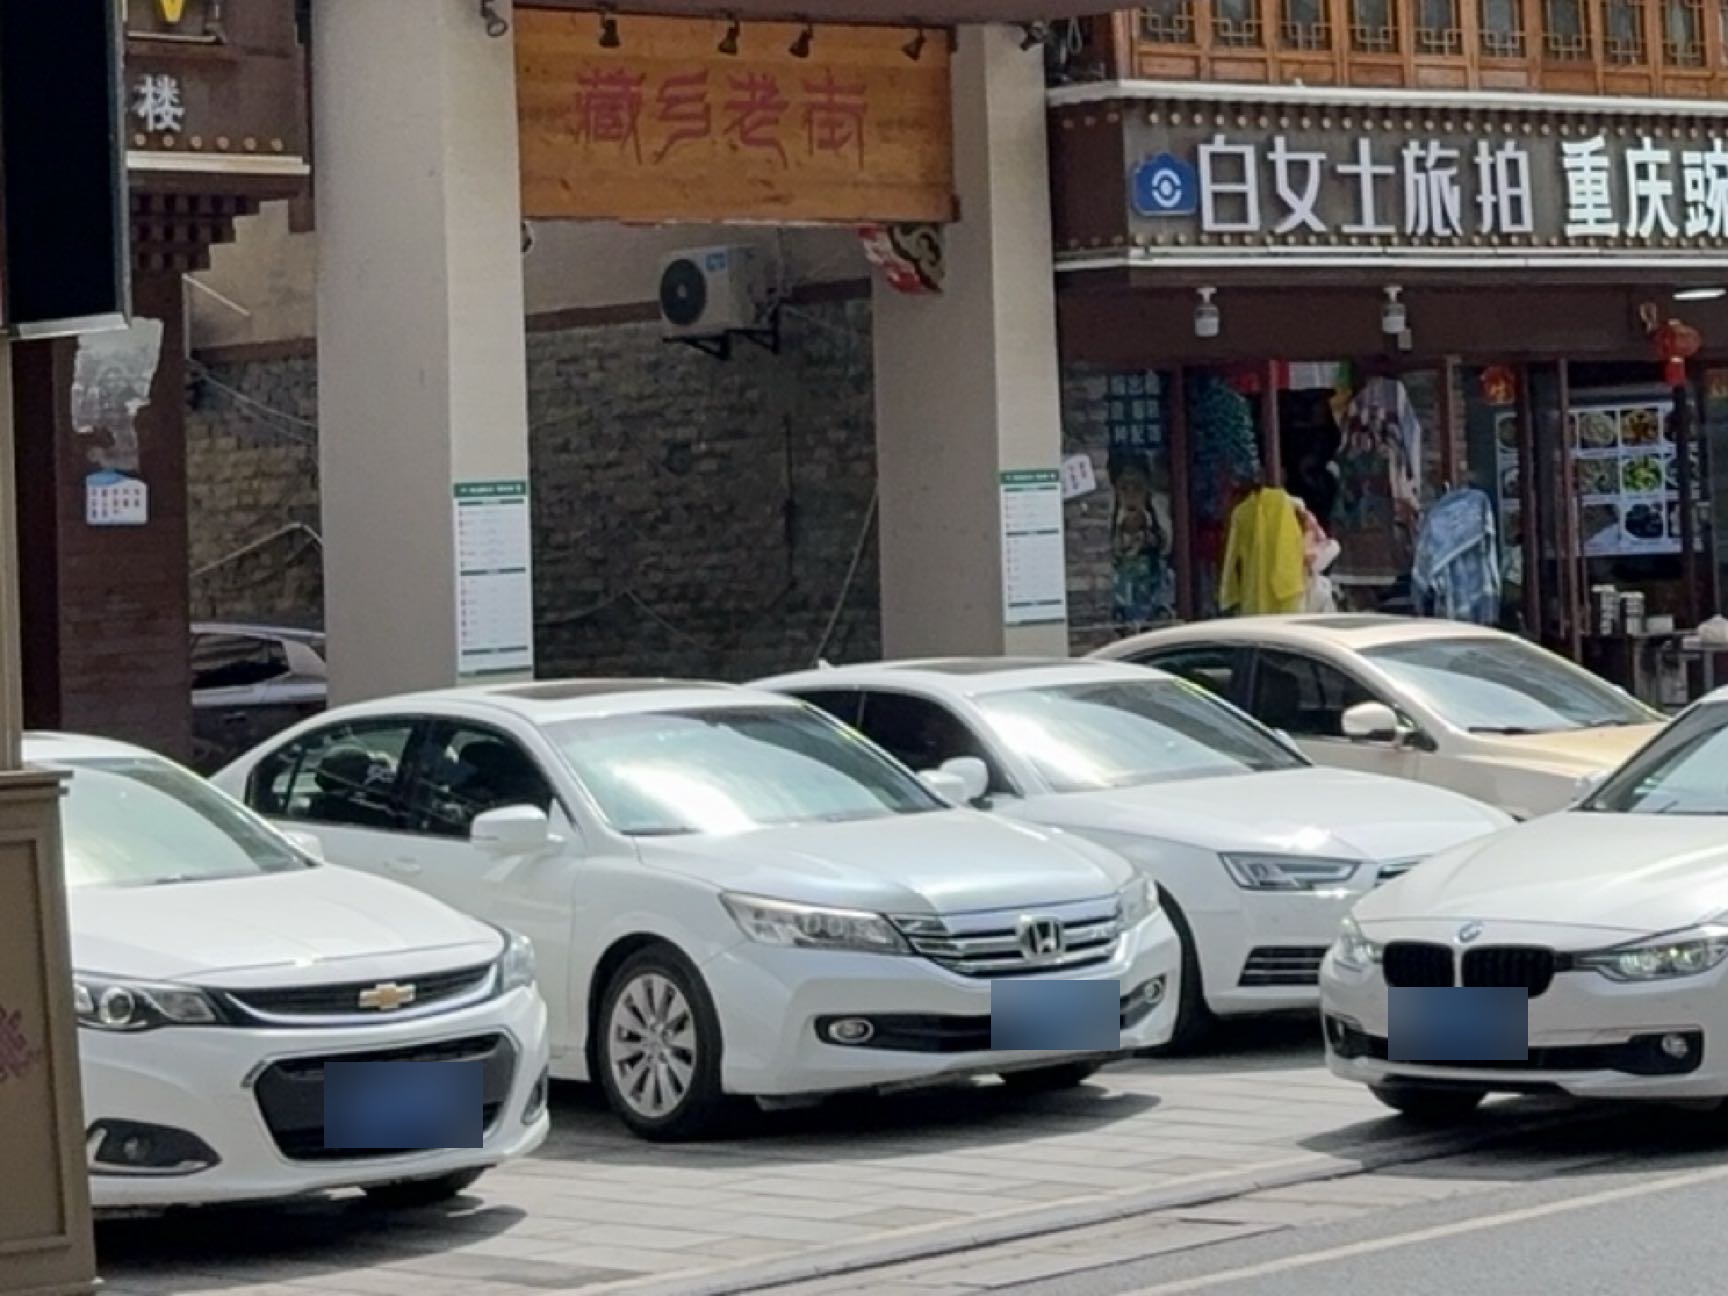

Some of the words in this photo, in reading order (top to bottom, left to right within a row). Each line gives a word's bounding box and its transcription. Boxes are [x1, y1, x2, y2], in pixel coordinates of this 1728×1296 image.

[1199, 133, 1534, 237] 白女士旅拍
